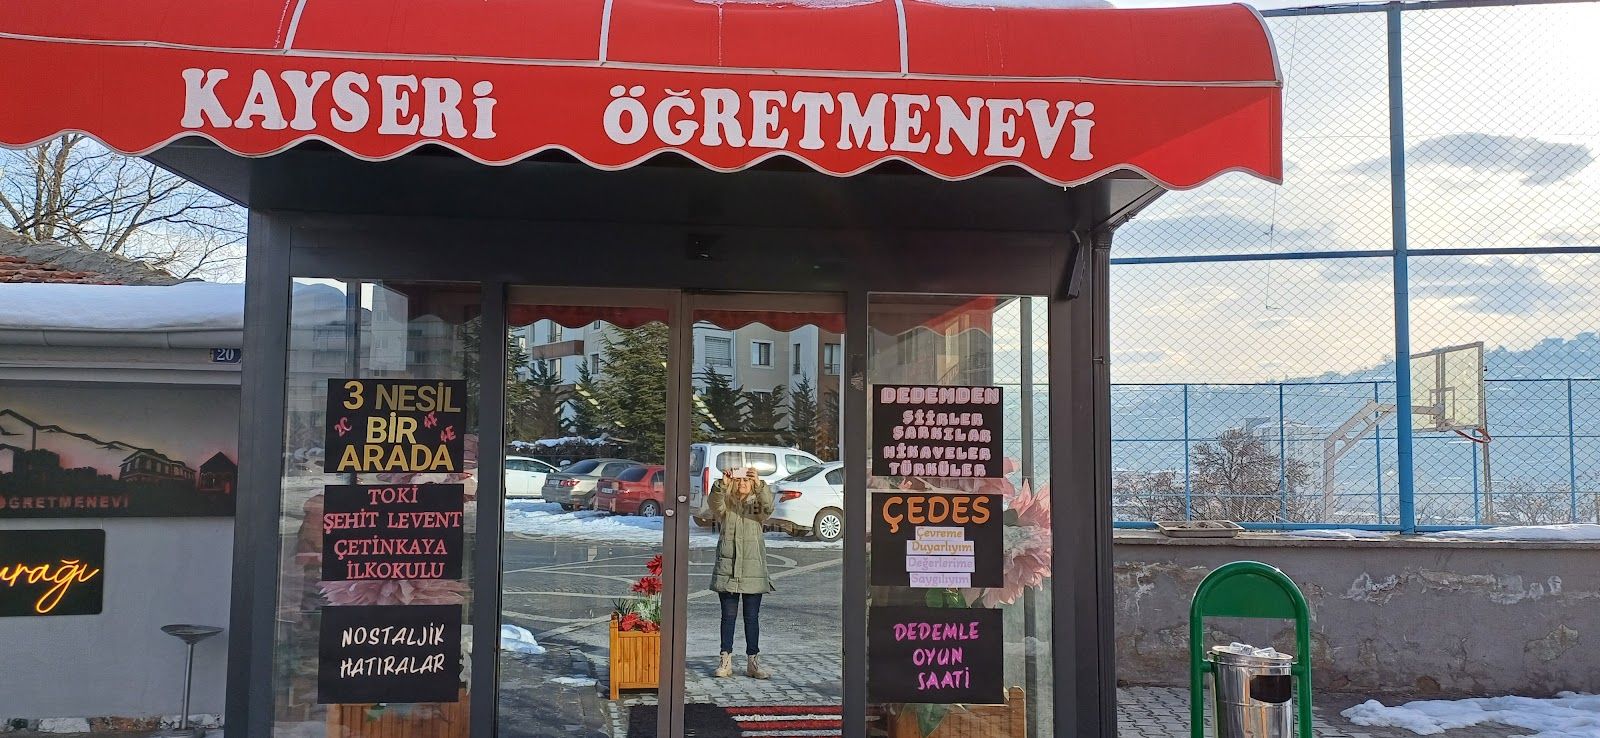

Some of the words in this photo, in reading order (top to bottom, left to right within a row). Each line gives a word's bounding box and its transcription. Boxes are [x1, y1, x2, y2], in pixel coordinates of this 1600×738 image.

[216, 348, 235, 361] 20
[343, 380, 365, 410] 3
[375, 382, 461, 412] NESİL
[880, 387, 1000, 405] DEDEMDEN
[366, 411, 418, 444] BİR
[902, 409, 984, 427] ŞİİRLER
[892, 425, 992, 443] ŞARKILAR
[337, 444, 455, 472] ARADA
[883, 442, 991, 460] HİKAYELER
[889, 459, 986, 477] TÜRKÜLER
[367, 484, 419, 506] TOKİ
[323, 508, 379, 535] ŞEHİT
[387, 511, 463, 529] LEVENT
[882, 496, 990, 533] ÇEDES
[916, 527, 963, 540] Çevreme
[334, 535, 448, 560] ÇETİNKAYA
[911, 541, 973, 555] Duyarlıyım
[346, 560, 446, 580] İLKOKULU
[908, 557, 974, 571] Değerlerime
[911, 573, 969, 587] Saygılıyım
[341, 622, 445, 648] NOSTALJİK
[892, 621, 980, 641] DEDEMLE
[340, 653, 445, 678] HATIRALAR
[912, 647, 963, 667] OYUN
[917, 666, 971, 690] SAATİ
